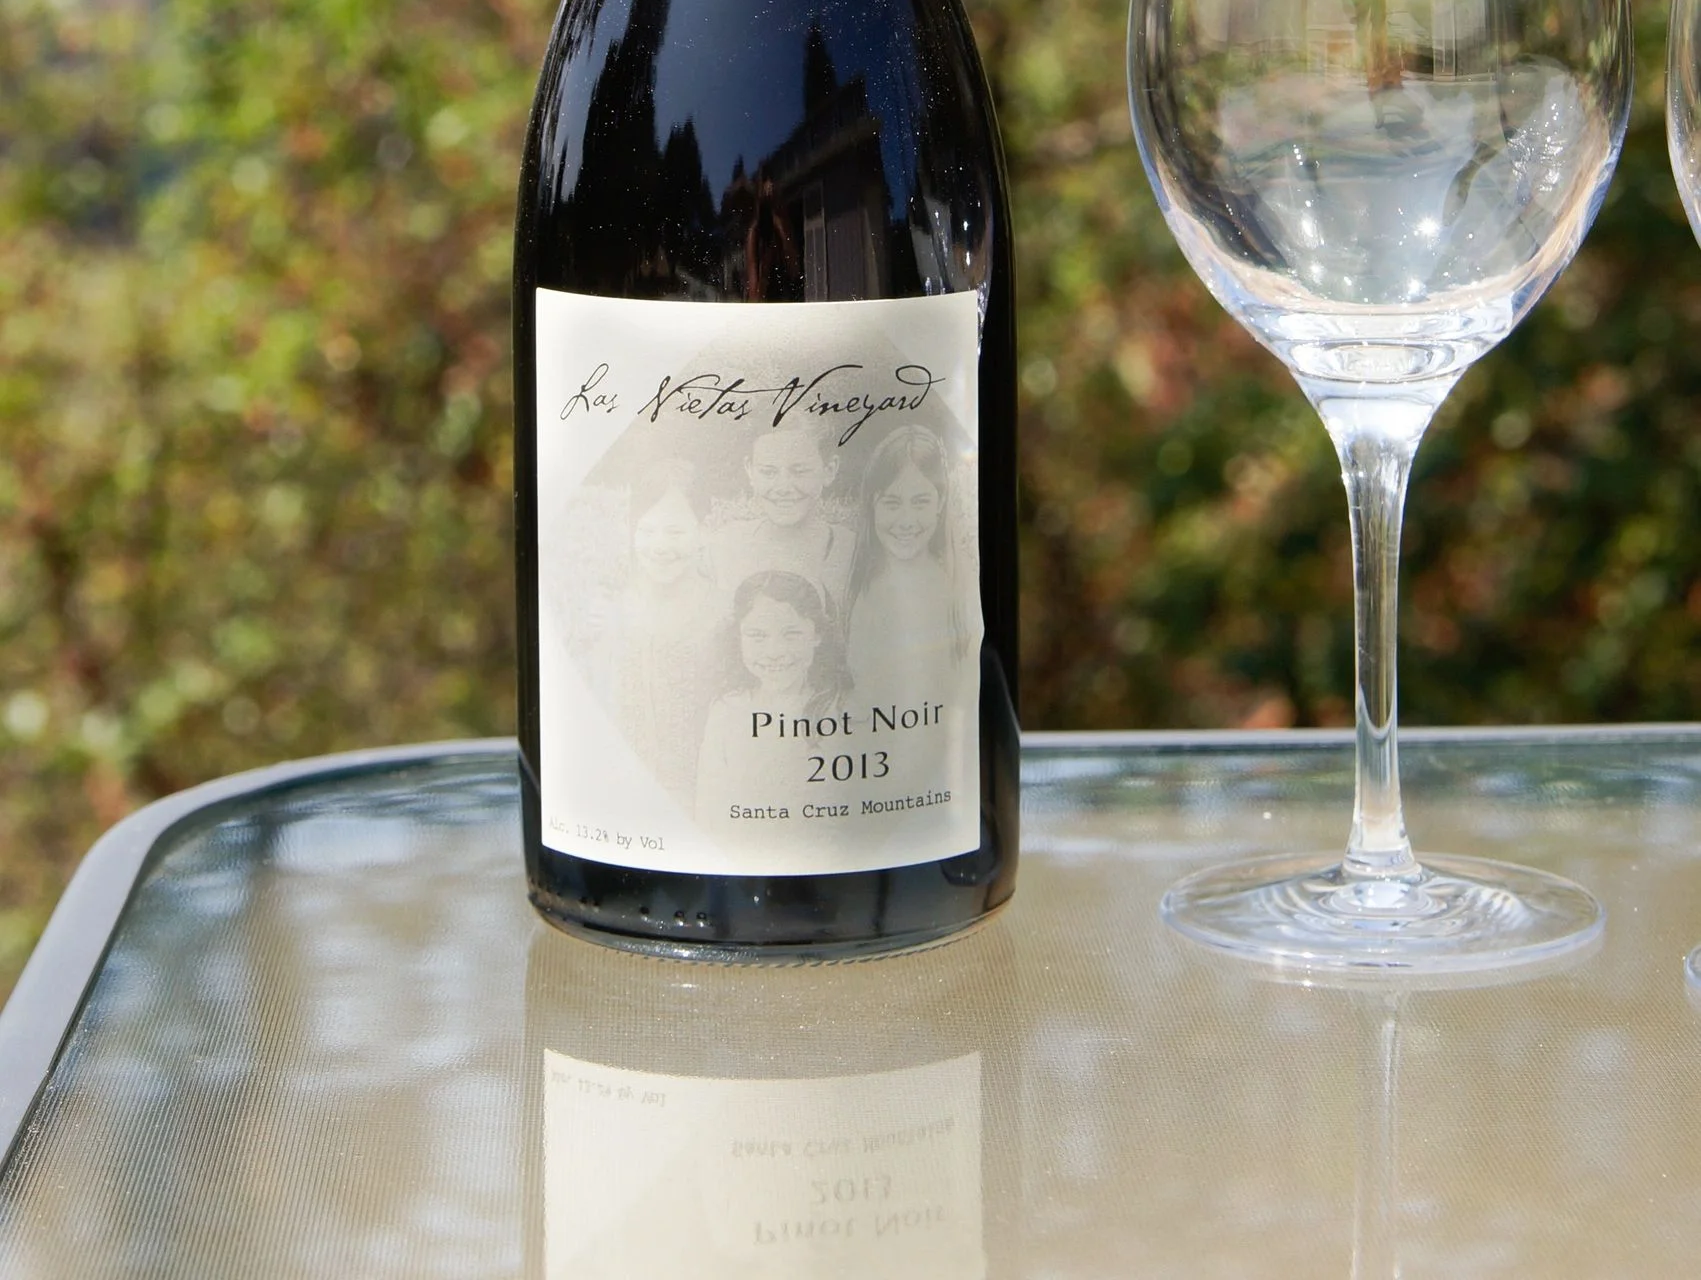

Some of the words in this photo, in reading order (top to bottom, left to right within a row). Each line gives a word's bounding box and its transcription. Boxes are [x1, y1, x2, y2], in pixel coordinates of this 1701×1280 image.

[561, 362, 620, 420] Las
[772, 364, 946, 447] Vineyard
[751, 711, 853, 738] Pinot
[871, 701, 944, 733] Noir
[806, 751, 890, 782] 2013
[730, 804, 790, 819] Santa
[802, 803, 849, 818] Cruz
[861, 790, 951, 815] Mountains
[616, 832, 632, 850] by
[640, 836, 665, 851] Vol
